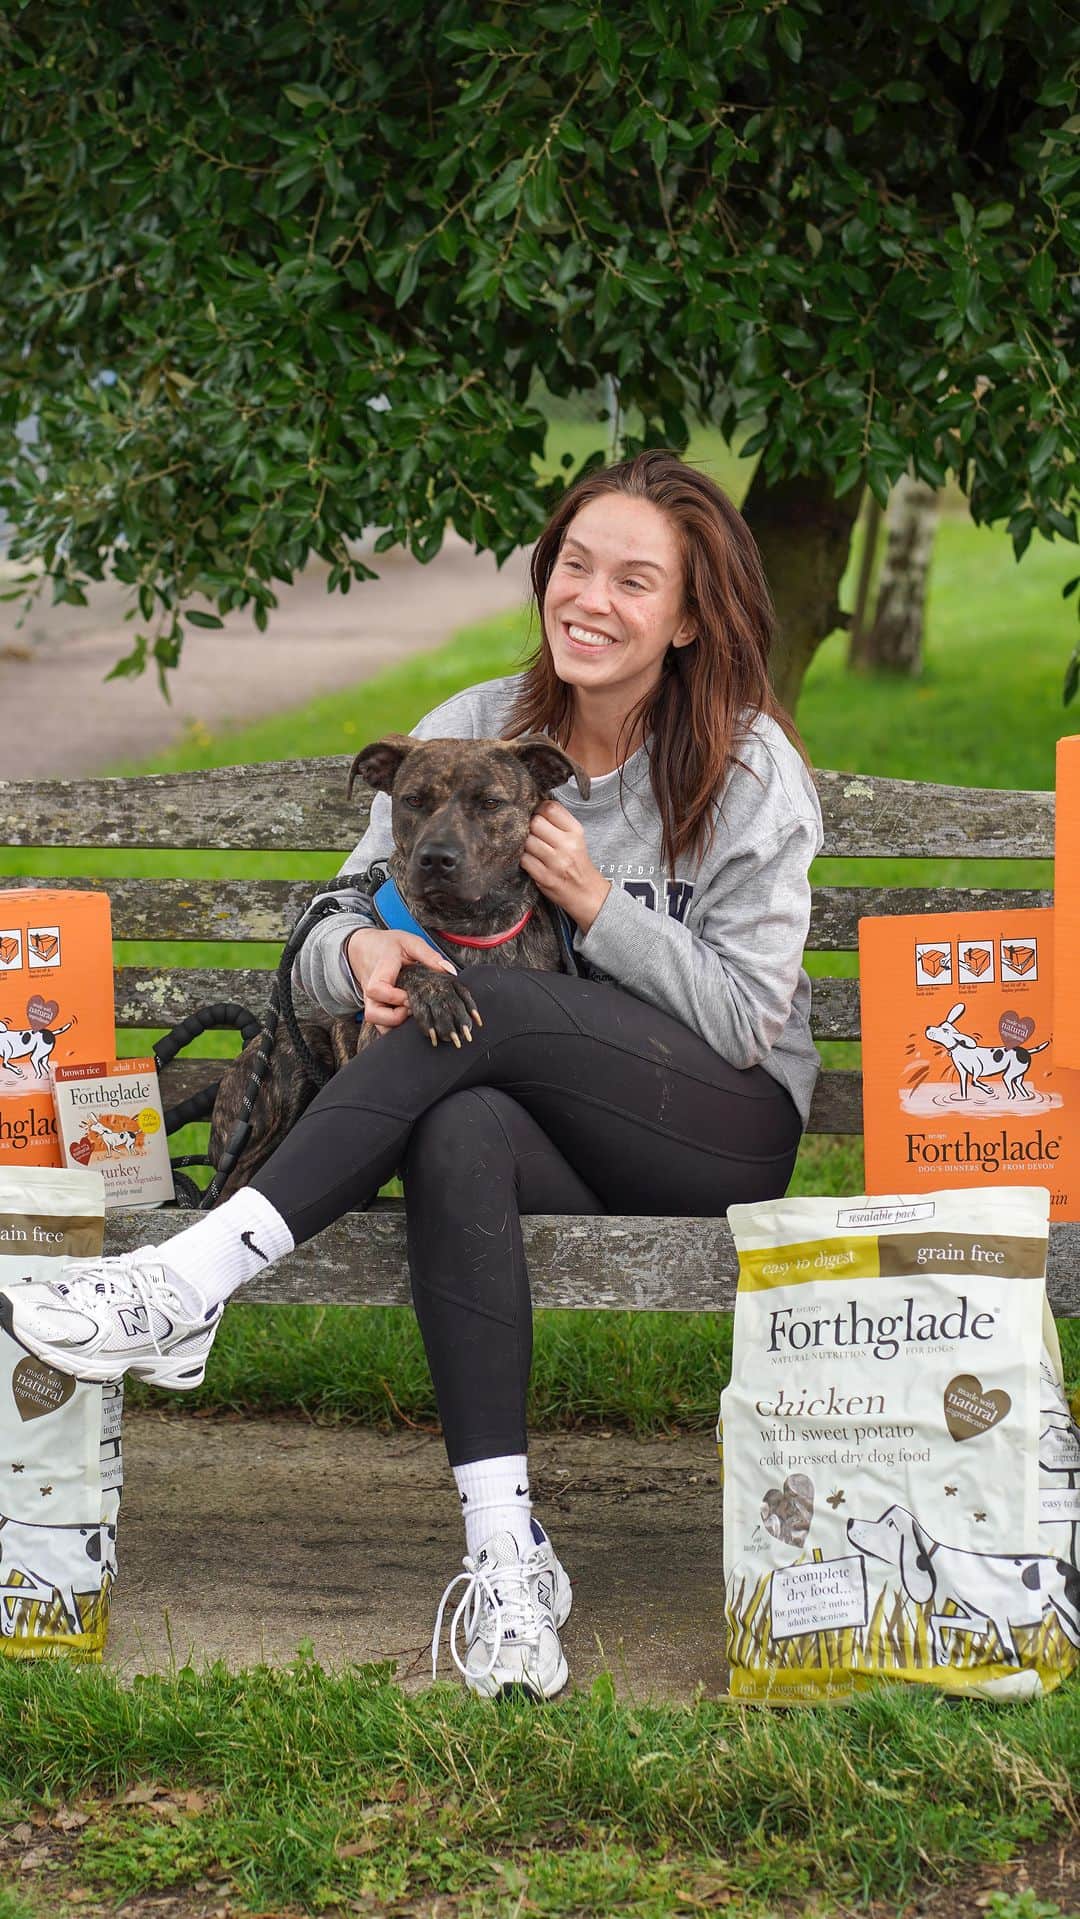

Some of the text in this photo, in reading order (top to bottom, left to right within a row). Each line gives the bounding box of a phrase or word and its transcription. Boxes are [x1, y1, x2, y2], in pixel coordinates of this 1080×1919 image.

[1002, 1022, 1029, 1037] natural
[61, 1066, 100, 1078] brown rice
[112, 1063, 130, 1072] adult
[70, 1081, 150, 1108] Forthglade
[905, 1129, 1061, 1173] Forthglade
[101, 1163, 141, 1179] turkey
[944, 1164, 980, 1173] DINNERS
[1002, 1163, 1025, 1171] FROM
[849, 1208, 916, 1223] resealable pack
[32, 1225, 64, 1242] free
[762, 1250, 857, 1275] easy to digest
[917, 1243, 1005, 1264] grain free
[767, 1296, 995, 1361] Forthglade
[770, 1345, 955, 1367] NATURAL NUTRITION FOR DOGS
[17, 1374, 64, 1402] natural
[26, 1368, 64, 1391] made with
[755, 1387, 886, 1417] chicken
[957, 1387, 979, 1402] made
[948, 1392, 999, 1423] natural
[760, 1424, 914, 1445] with sweet potato
[760, 1447, 931, 1469] cold pressed dry dog food
[1042, 1501, 1062, 1512] easy
[1064, 1500, 1073, 1509] to
[782, 1567, 850, 1587] a complete
[787, 1589, 807, 1602] dry
[775, 1609, 787, 1618] for
[787, 1604, 817, 1618] puppies
[787, 1617, 810, 1628] adults
[811, 1615, 819, 1624] &
